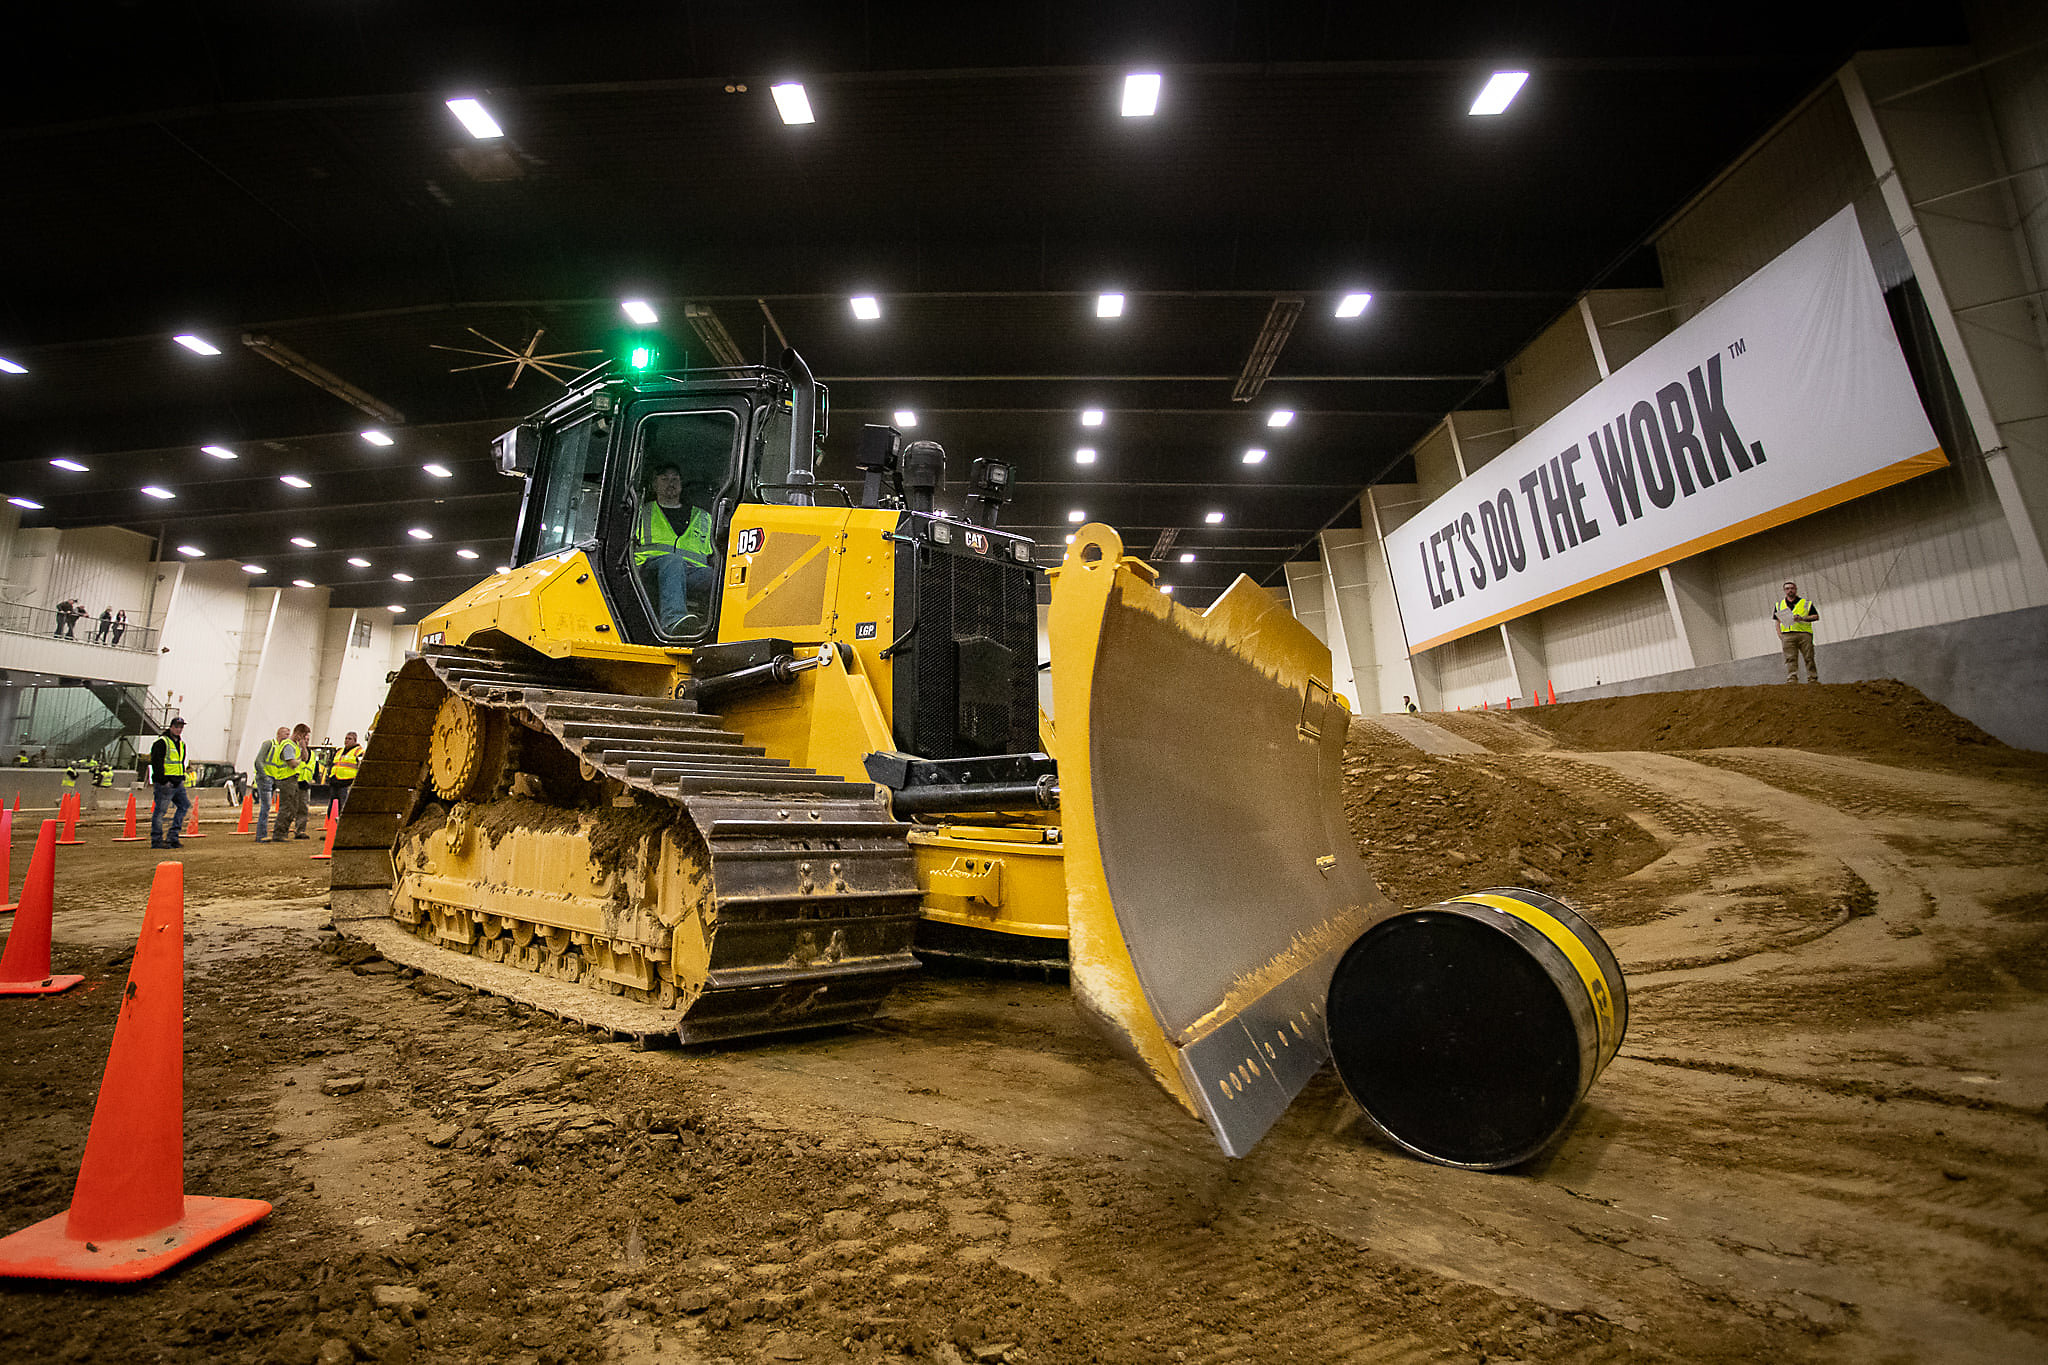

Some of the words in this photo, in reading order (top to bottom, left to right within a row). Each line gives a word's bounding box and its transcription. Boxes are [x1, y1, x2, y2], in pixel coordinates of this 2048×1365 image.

[1419, 511, 1487, 609] LET'S
[1479, 488, 1527, 581] DO
[1519, 443, 1600, 560] THE
[1588, 352, 1767, 527] WORK.
[738, 529, 758, 554] D5
[965, 531, 982, 549] CAT
